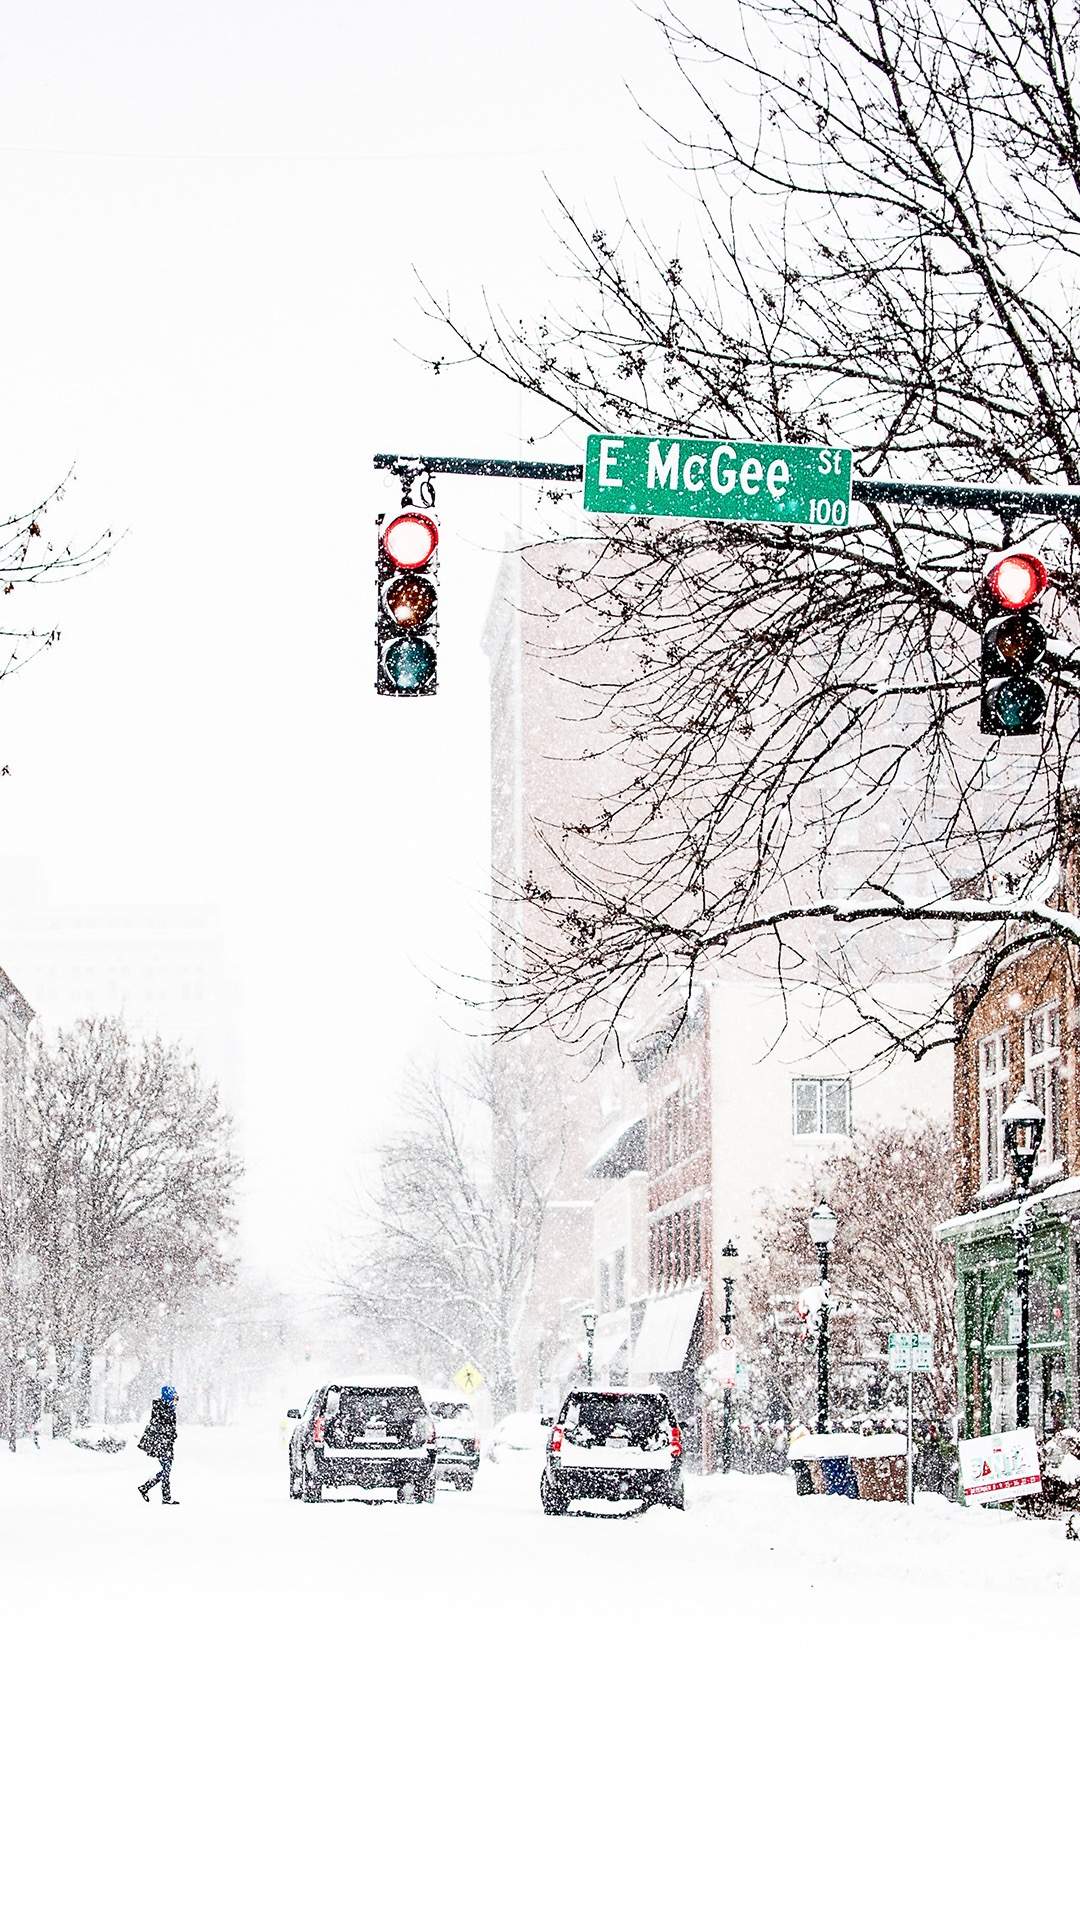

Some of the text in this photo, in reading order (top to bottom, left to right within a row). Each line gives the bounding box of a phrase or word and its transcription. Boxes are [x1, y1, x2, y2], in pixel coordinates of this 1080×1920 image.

[599, 440, 842, 498] E McGee St
[809, 499, 846, 524] 100
